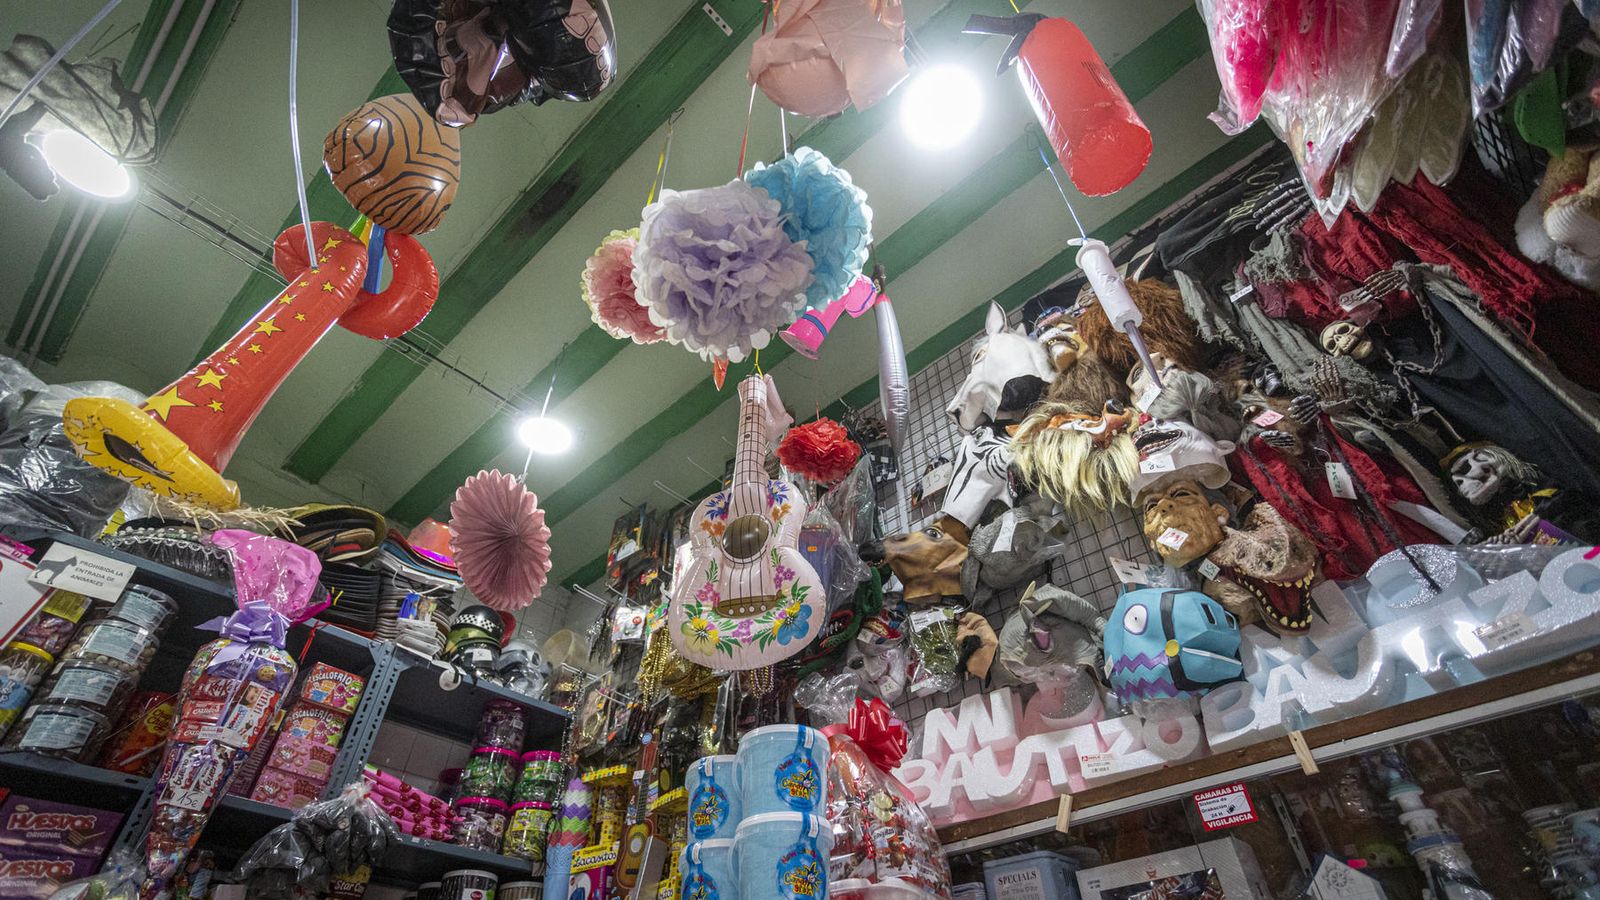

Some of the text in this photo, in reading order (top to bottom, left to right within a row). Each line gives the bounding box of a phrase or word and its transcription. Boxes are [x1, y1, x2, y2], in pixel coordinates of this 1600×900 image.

[75, 567, 116, 582] ENTRADA DE
[79, 560, 114, 576] PROHIBIDA
[70, 573, 104, 587] ANIMALES
[1203, 547, 1600, 744] BAUTIZO
[891, 707, 1200, 806] BAUTIZO
[1195, 784, 1244, 800] CAMARAS DE
[1208, 813, 1253, 827] VIGILANCIA
[26, 831, 62, 839] ORIGINAL
[998, 870, 1037, 886] SPECIALS
